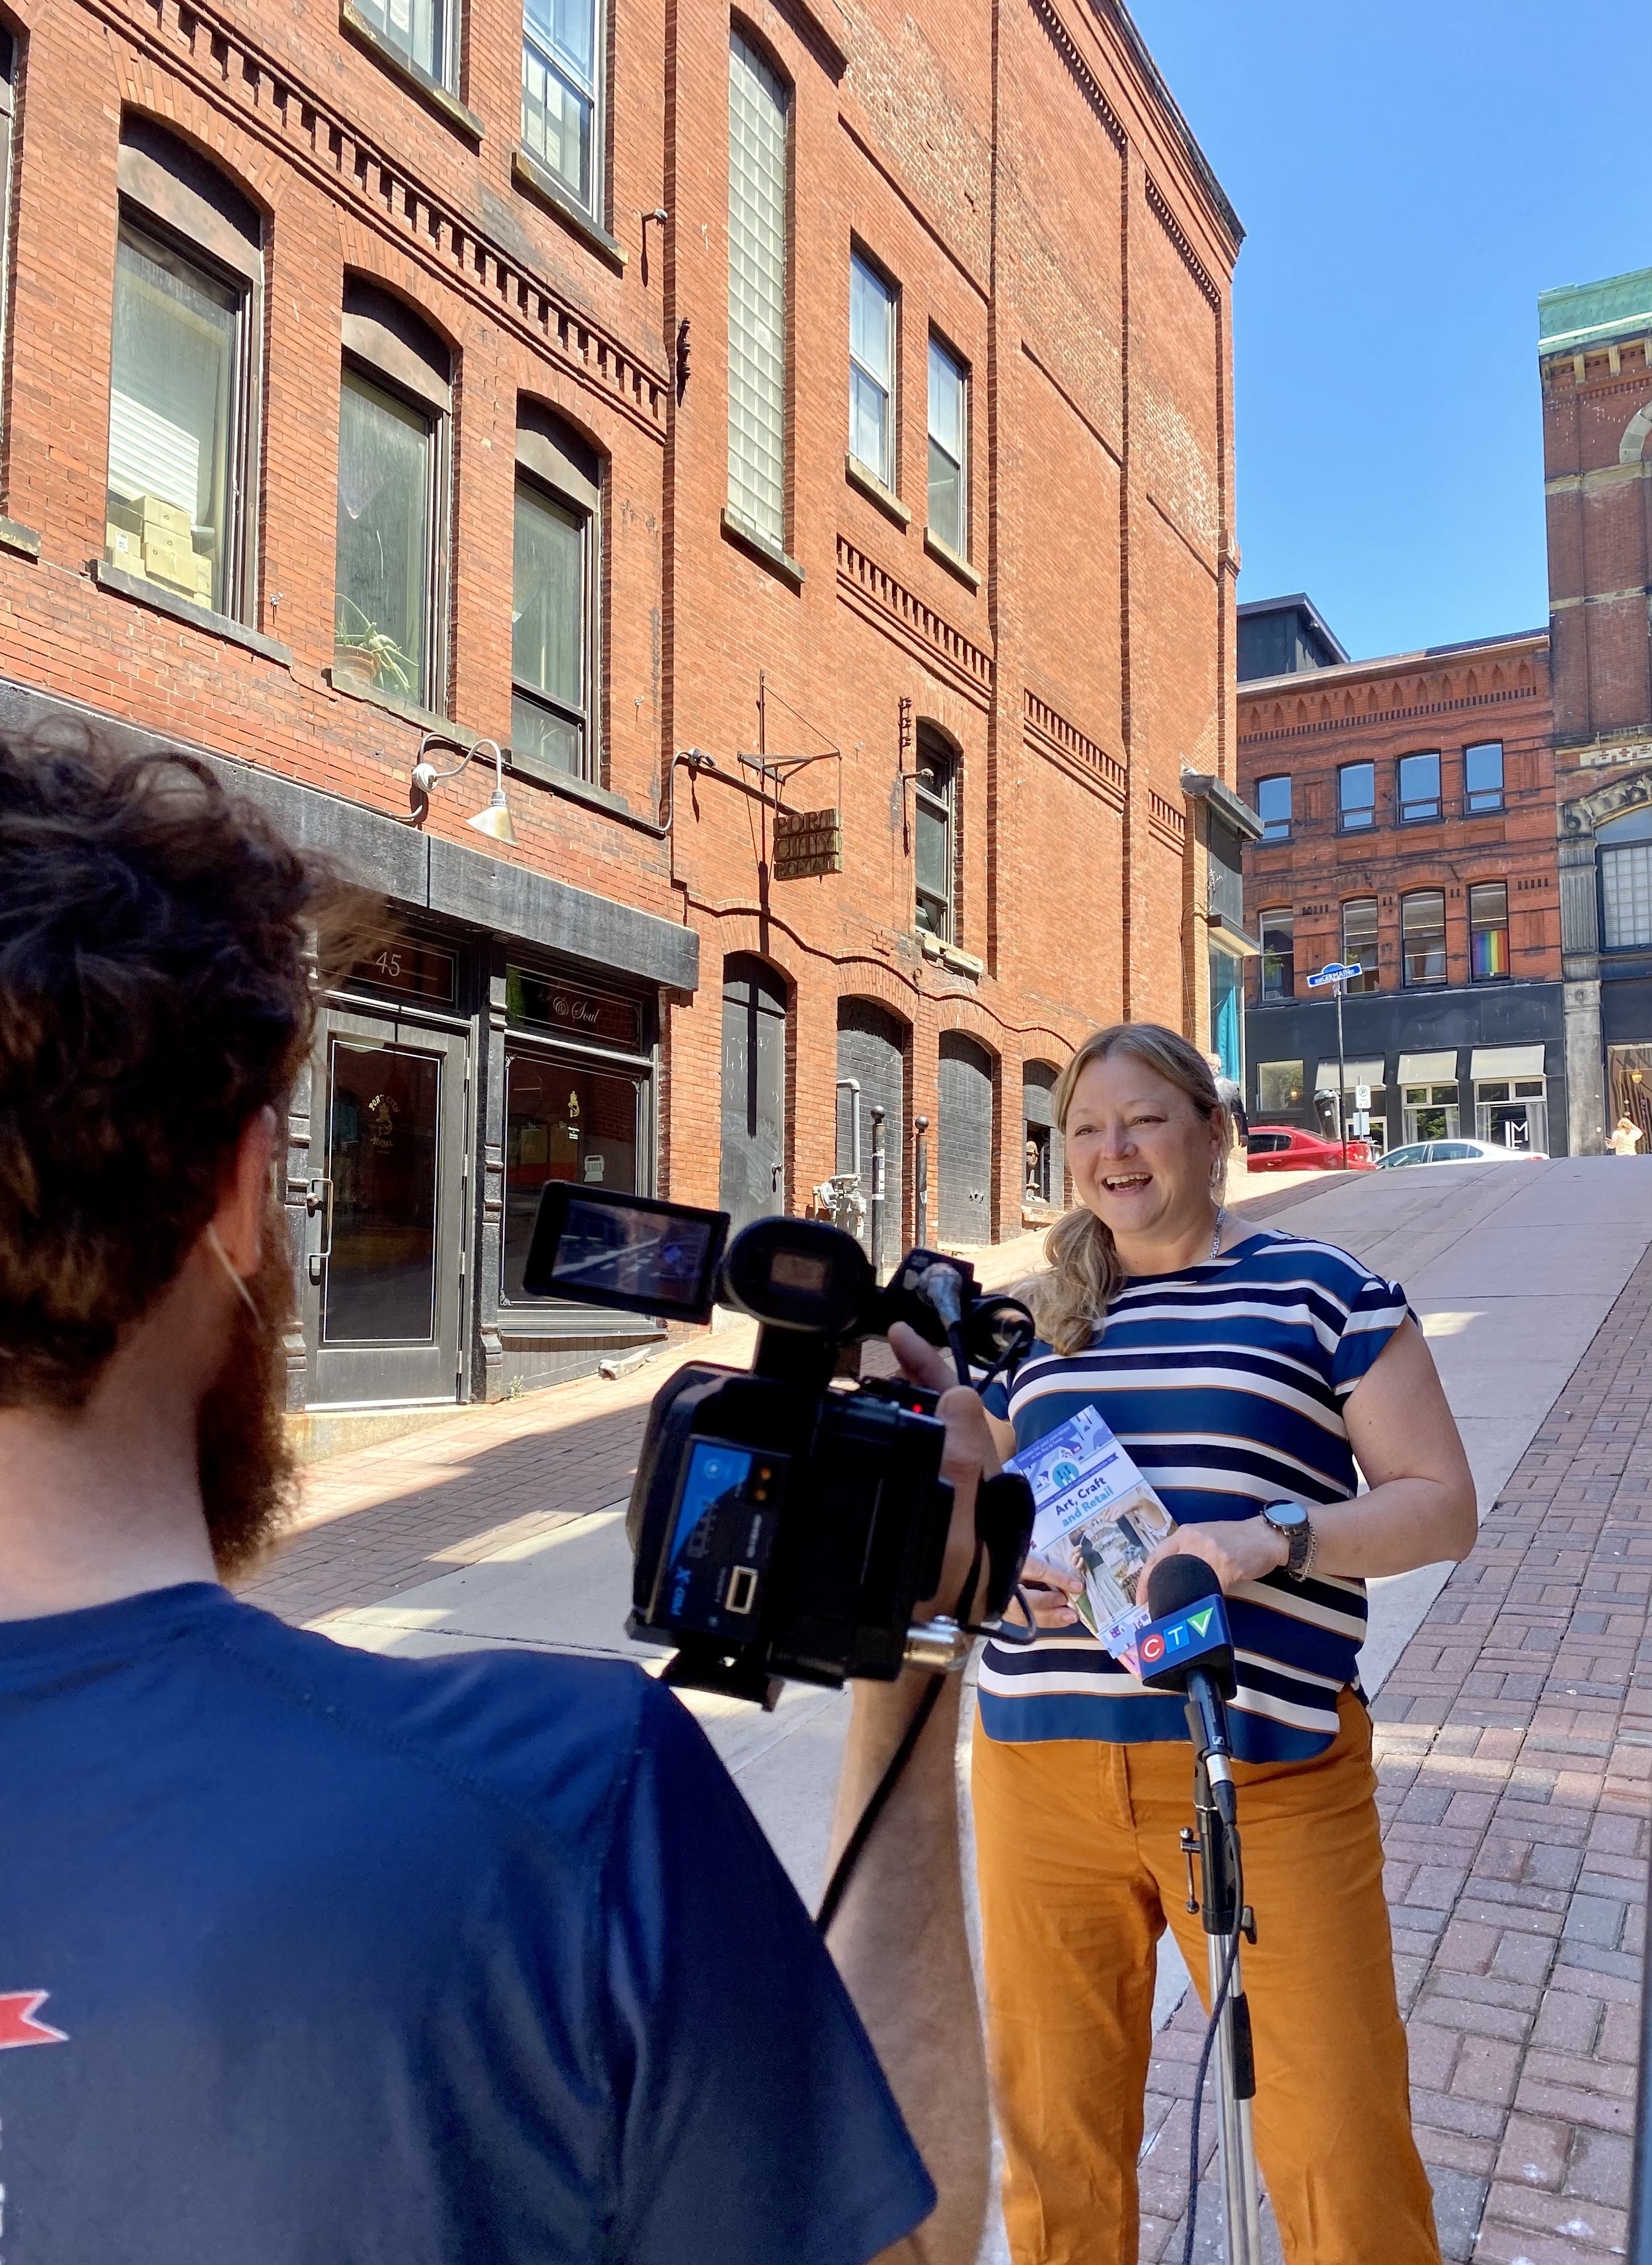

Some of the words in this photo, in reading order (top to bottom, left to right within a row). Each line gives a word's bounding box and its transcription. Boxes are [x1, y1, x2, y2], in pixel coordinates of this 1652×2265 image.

[773, 808, 835, 837] PORT
[774, 832, 835, 861] CITY
[773, 855, 835, 878] ROYAL
[375, 951, 402, 977] 45
[1322, 968, 1350, 981] GERMAIN
[572, 1001, 600, 1023] Soul
[369, 1094, 385, 1111] PORT
[370, 1135, 394, 1147] ROYAL
[1056, 1498, 1078, 1516] Art,
[1078, 1477, 1106, 1499] Craft
[1062, 1508, 1082, 1527] and
[1081, 1485, 1114, 1512] Retail
[1144, 1613, 1210, 1658] CTV
